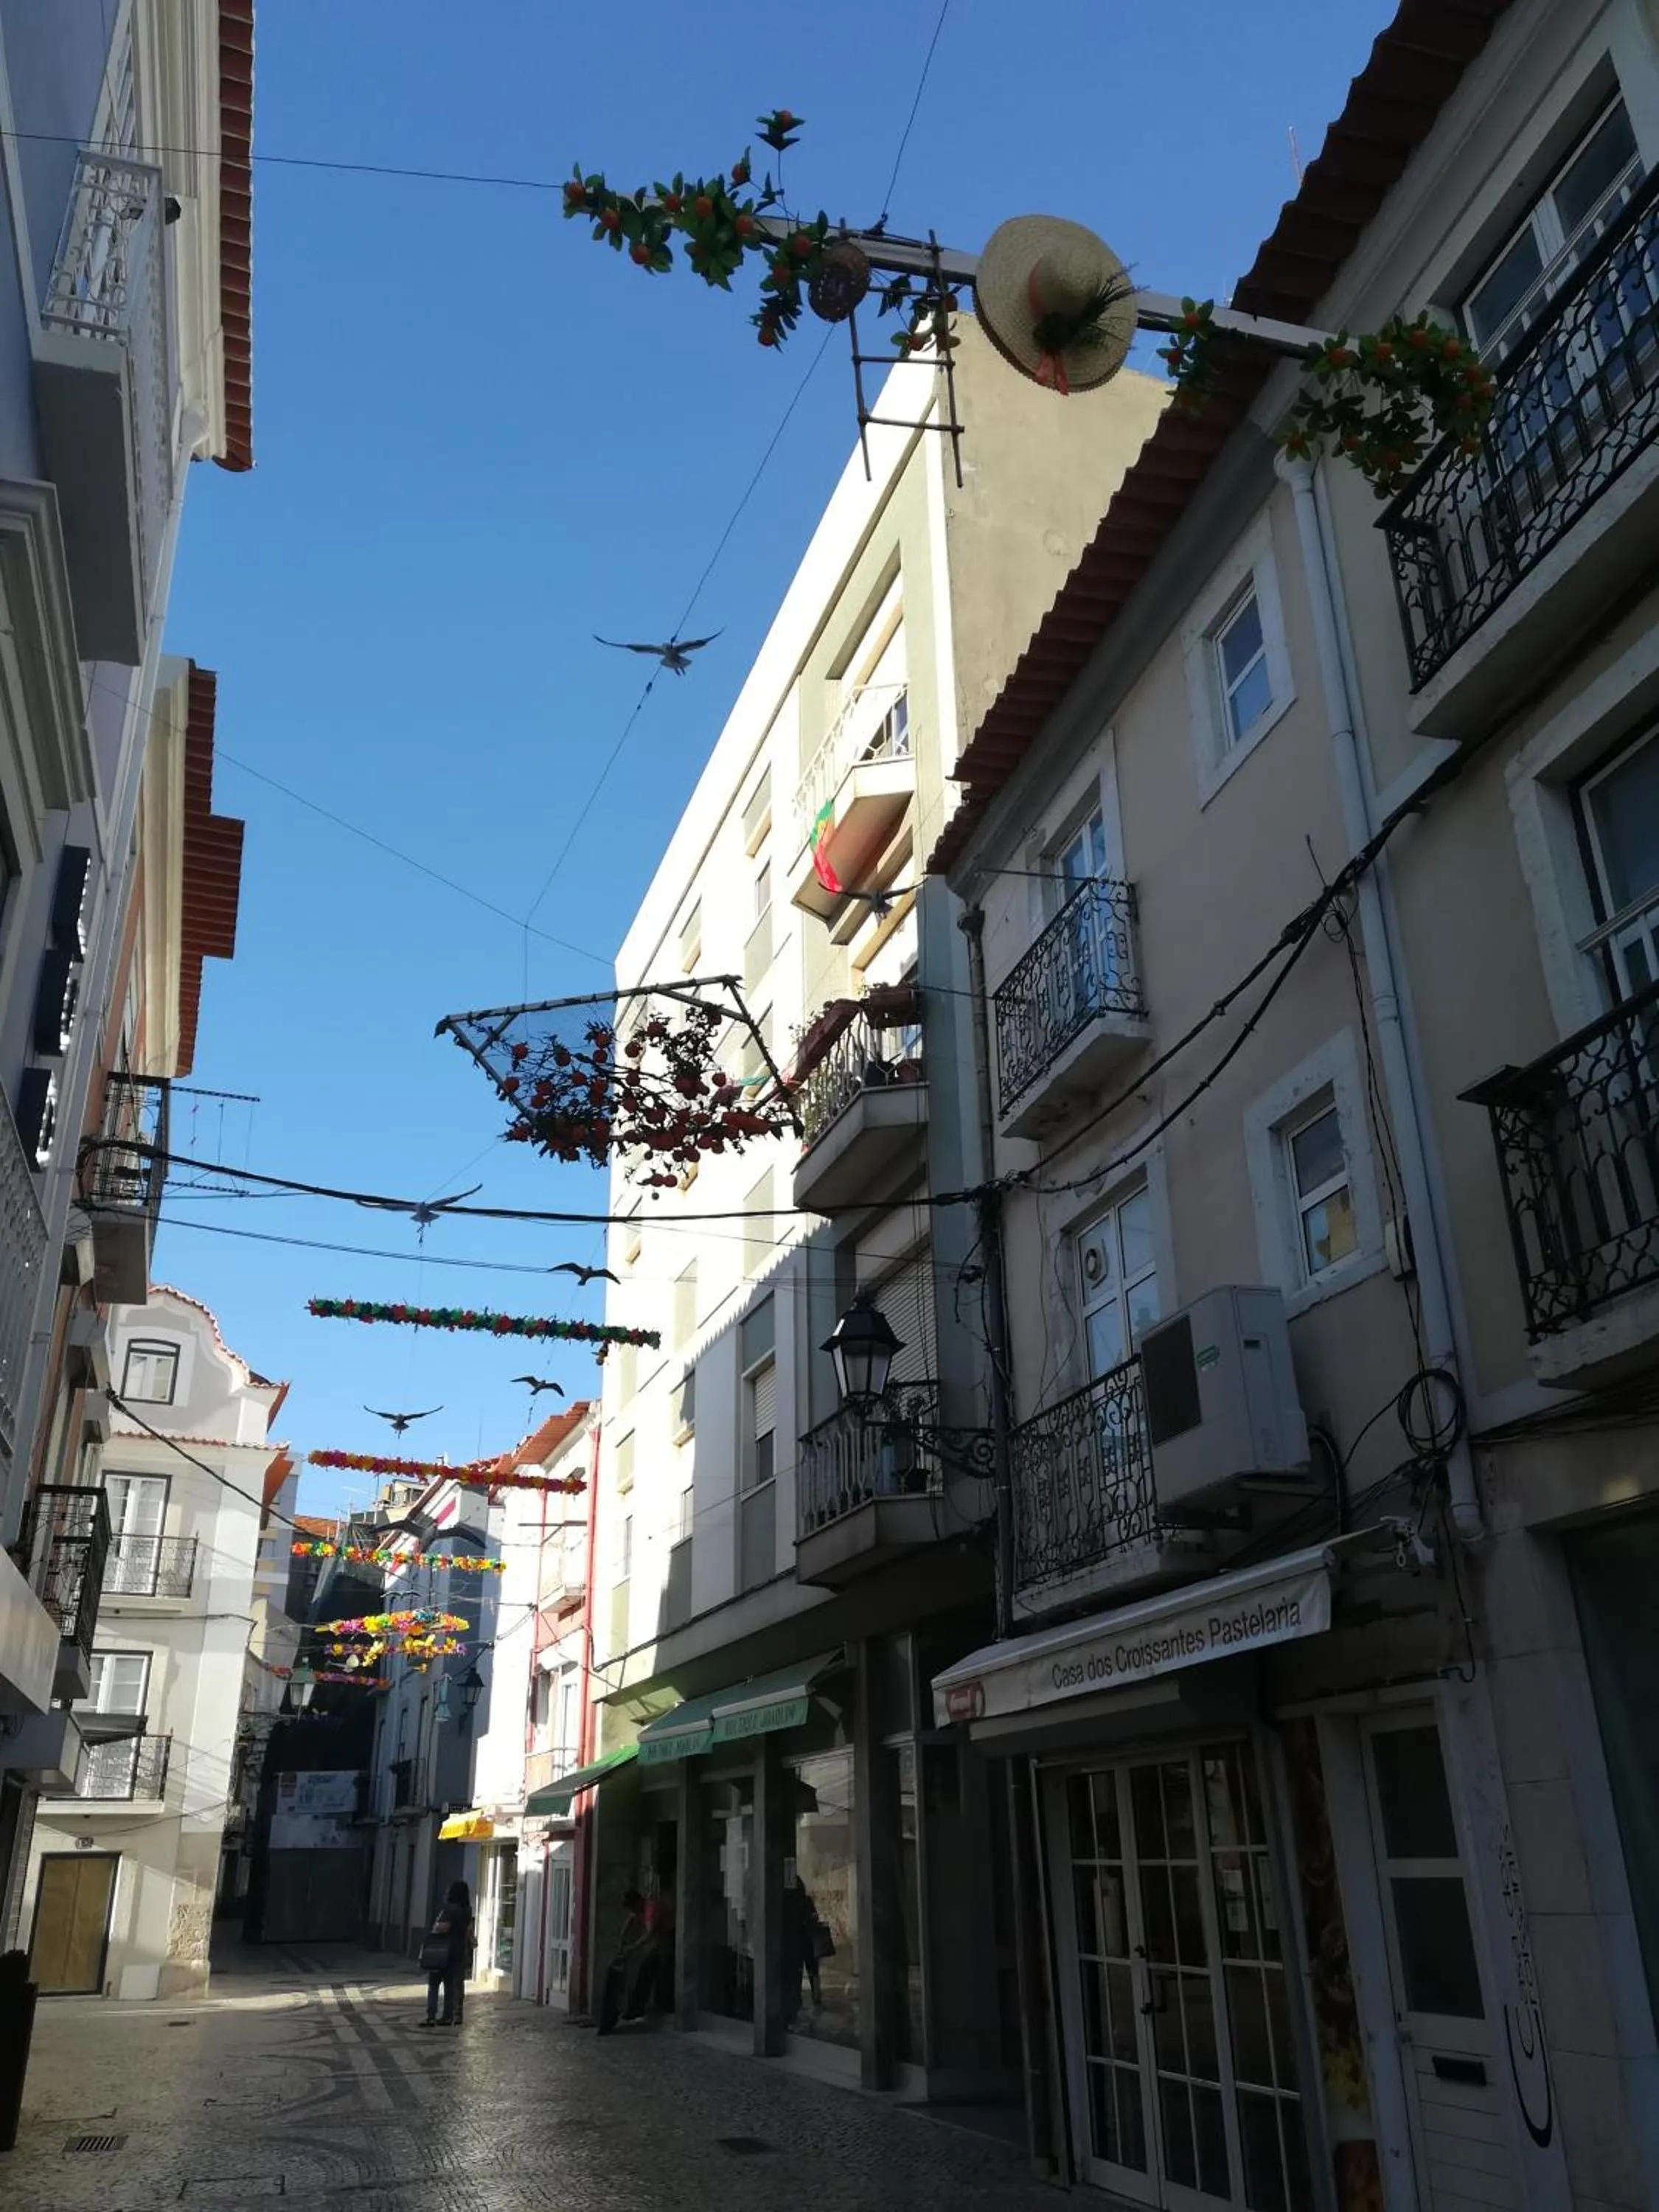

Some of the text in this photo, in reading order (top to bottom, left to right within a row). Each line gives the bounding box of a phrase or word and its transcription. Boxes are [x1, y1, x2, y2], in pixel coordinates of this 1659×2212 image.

[1051, 1596, 1302, 1689] Casa dos Croissantes Pastelaria
